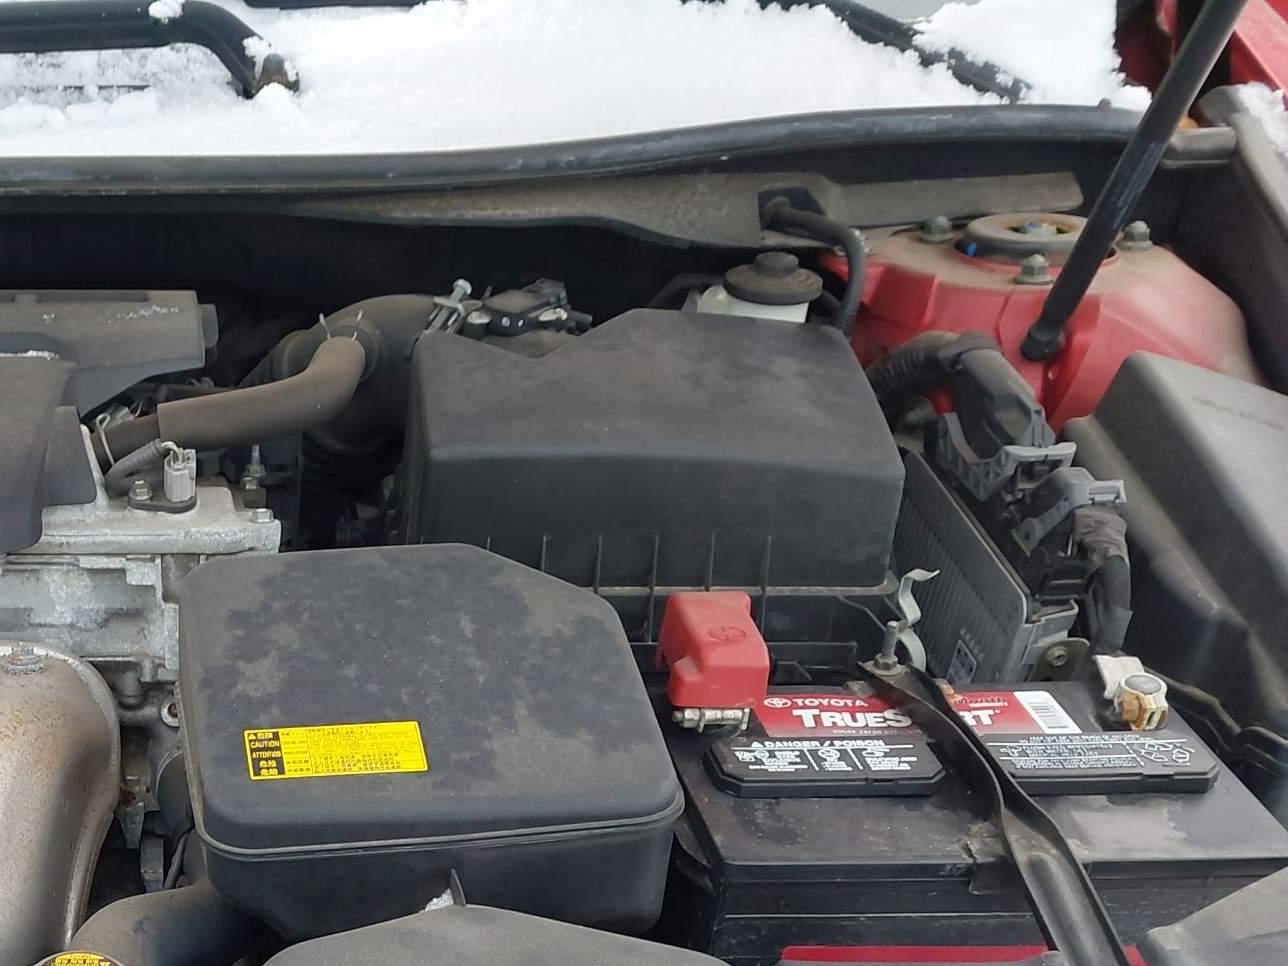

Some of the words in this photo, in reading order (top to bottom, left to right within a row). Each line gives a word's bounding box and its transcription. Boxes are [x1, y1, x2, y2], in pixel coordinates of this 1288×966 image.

[792, 698, 868, 707] TOYOTA
[763, 740, 821, 748] DANGER
[833, 739, 885, 748] POISON
